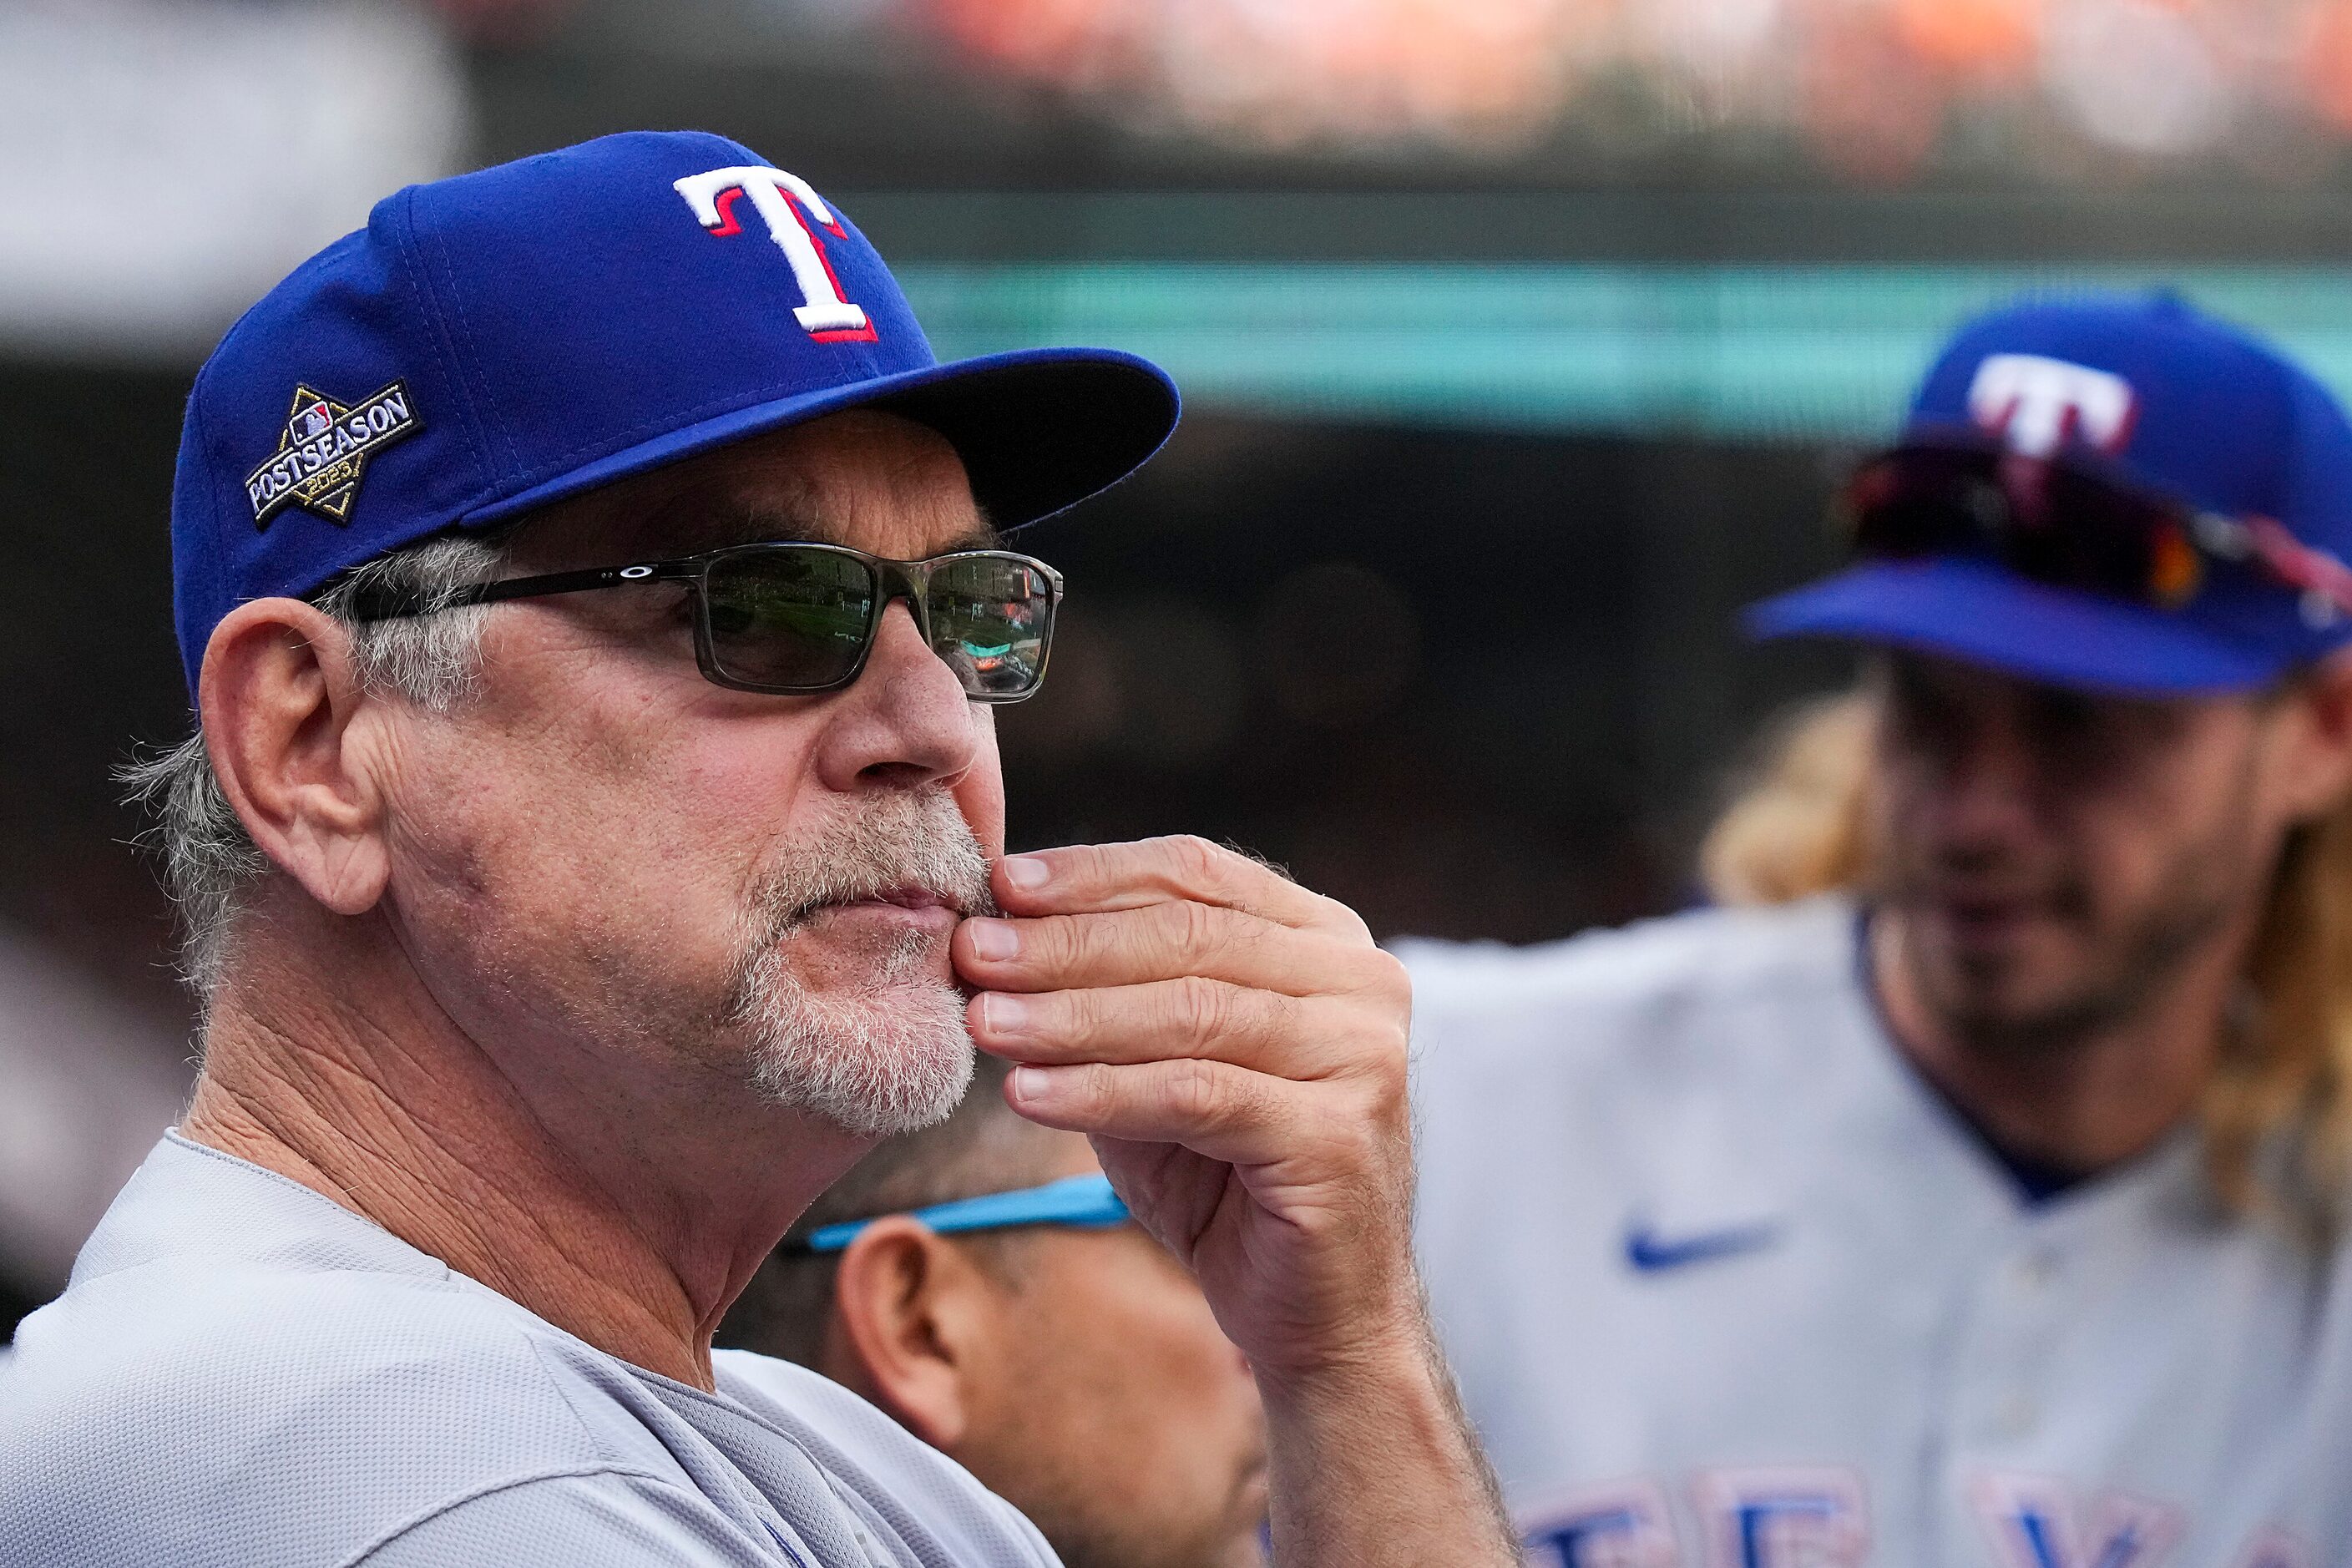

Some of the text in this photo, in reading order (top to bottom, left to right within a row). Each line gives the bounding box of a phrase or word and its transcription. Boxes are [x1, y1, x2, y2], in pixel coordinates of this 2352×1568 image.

[673, 166, 878, 343] T
[249, 392, 409, 513] POSTSEASON
[306, 461, 352, 498] 2023
